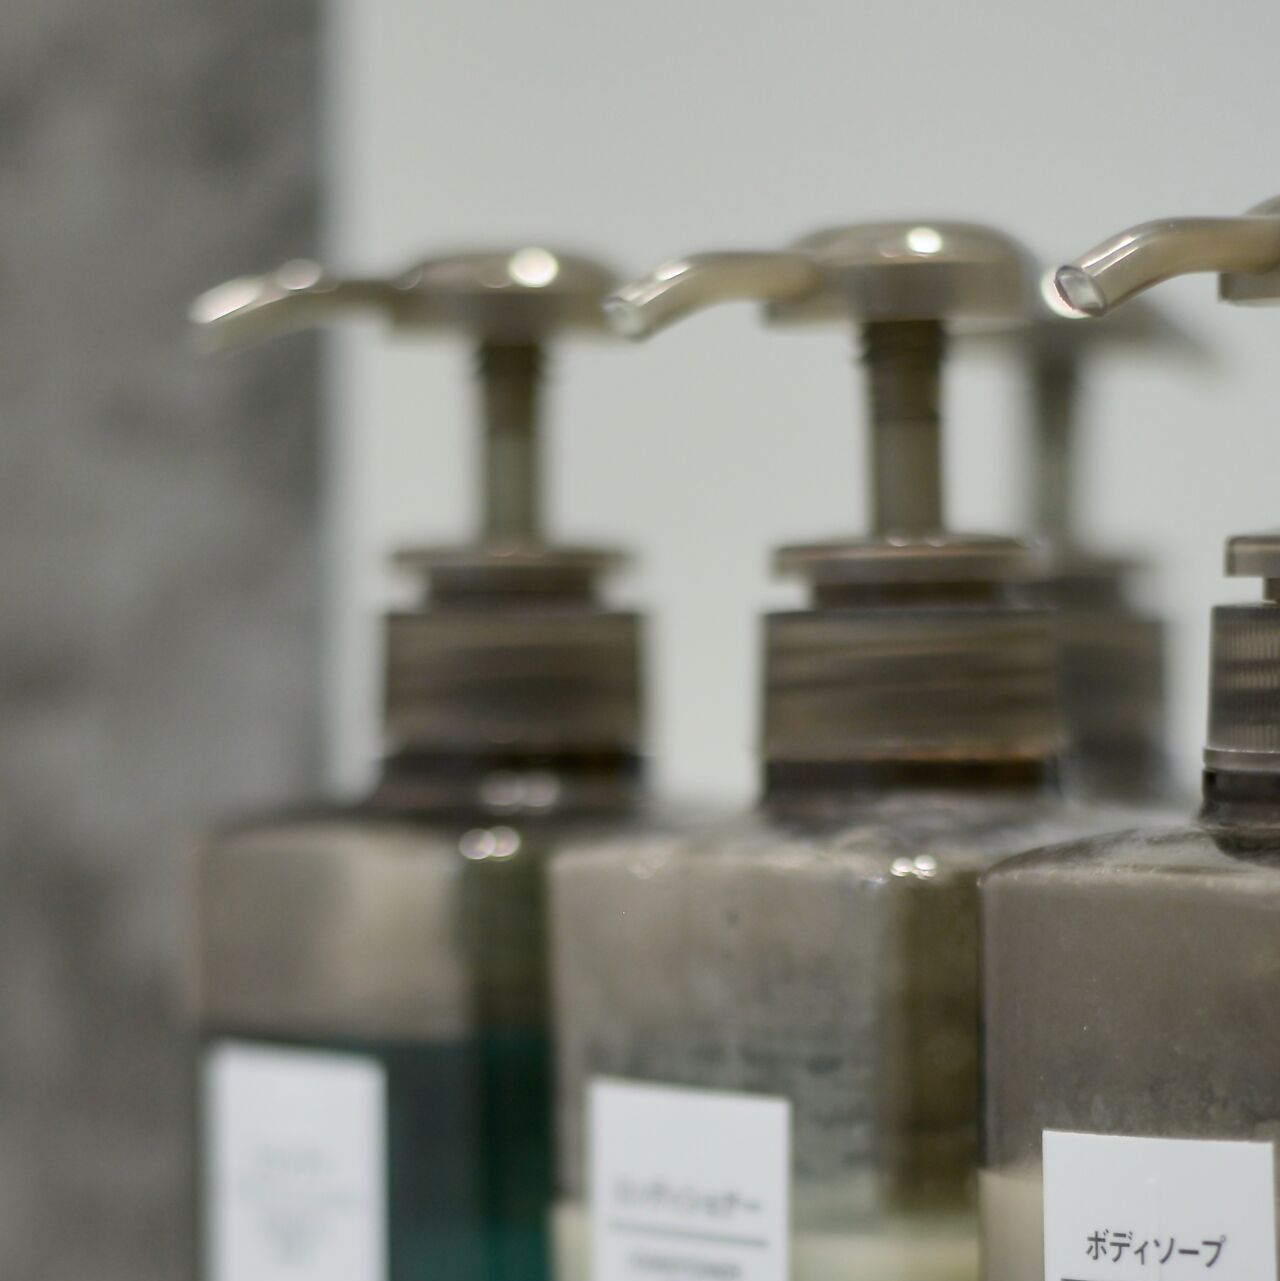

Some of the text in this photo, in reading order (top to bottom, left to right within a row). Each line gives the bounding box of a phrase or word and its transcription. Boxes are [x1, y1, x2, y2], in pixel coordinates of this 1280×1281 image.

[1085, 1228, 1227, 1269] ボディソープ
